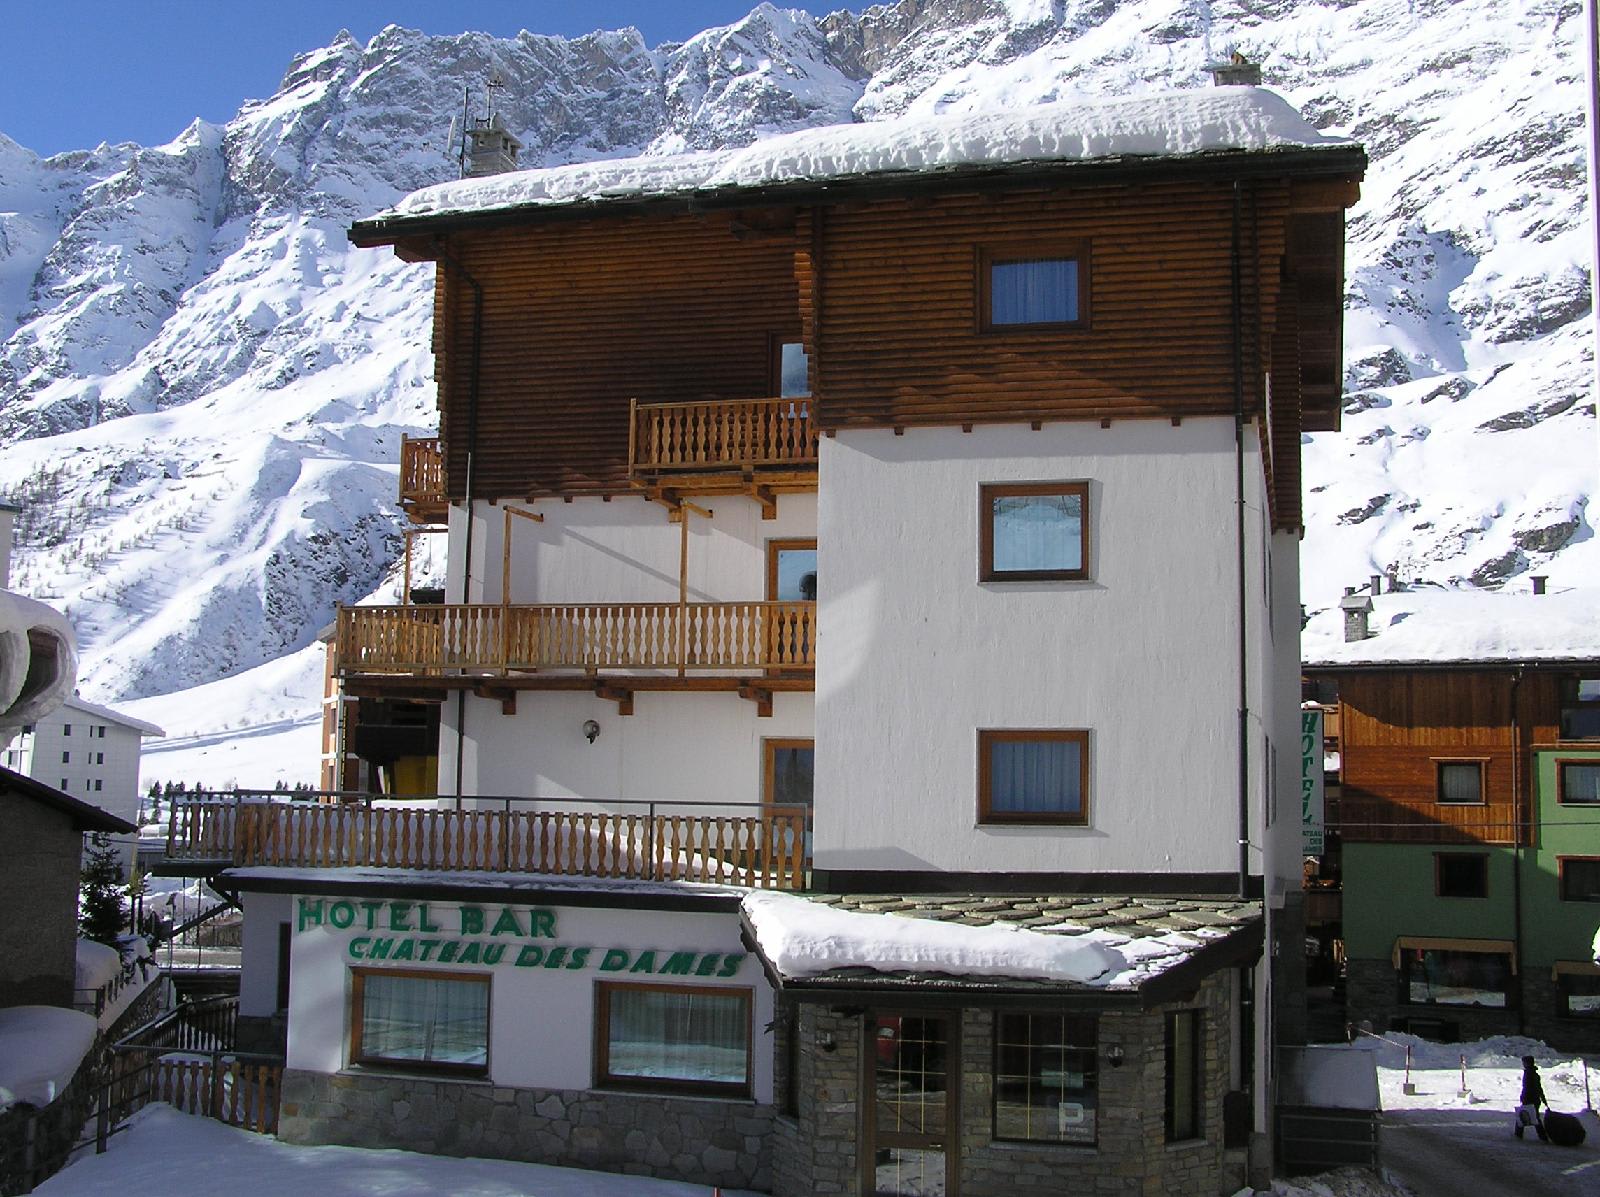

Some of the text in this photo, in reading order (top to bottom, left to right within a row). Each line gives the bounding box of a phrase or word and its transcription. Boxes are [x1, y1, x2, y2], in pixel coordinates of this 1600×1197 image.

[1302, 711, 1318, 826] HOTEL
[298, 899, 558, 938] HOTEL BAR
[348, 937, 747, 977] CHATEAU DES DAMES
